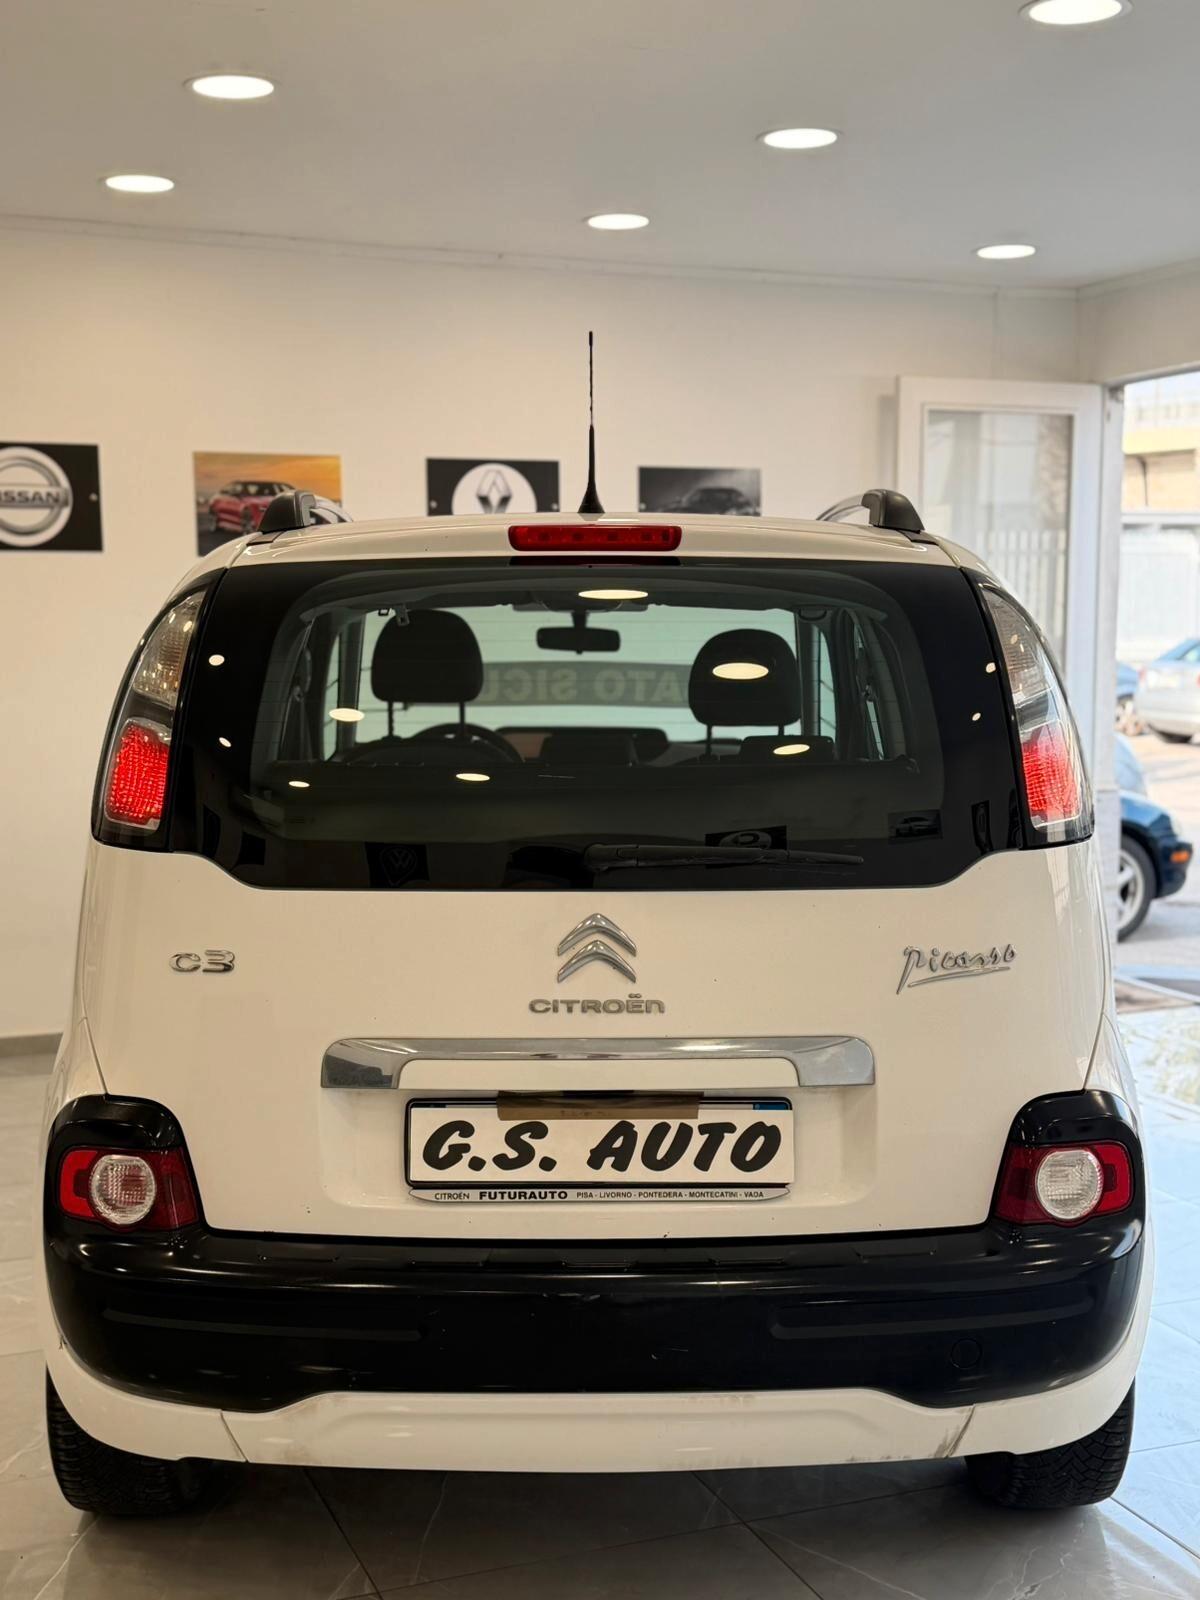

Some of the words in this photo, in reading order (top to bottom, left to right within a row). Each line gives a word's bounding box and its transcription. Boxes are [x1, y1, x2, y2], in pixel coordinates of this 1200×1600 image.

[169, 949, 236, 973] C3
[896, 944, 1016, 995] Picasso
[422, 1120, 557, 1172] G.S.
[586, 1120, 782, 1172] AUTO
[479, 1191, 568, 1200] FUTURAUTO
[638, 1191, 684, 1199] PONTEDERA
[689, 1191, 738, 1199] MONTECATINI
[744, 1191, 764, 1199] VADA
